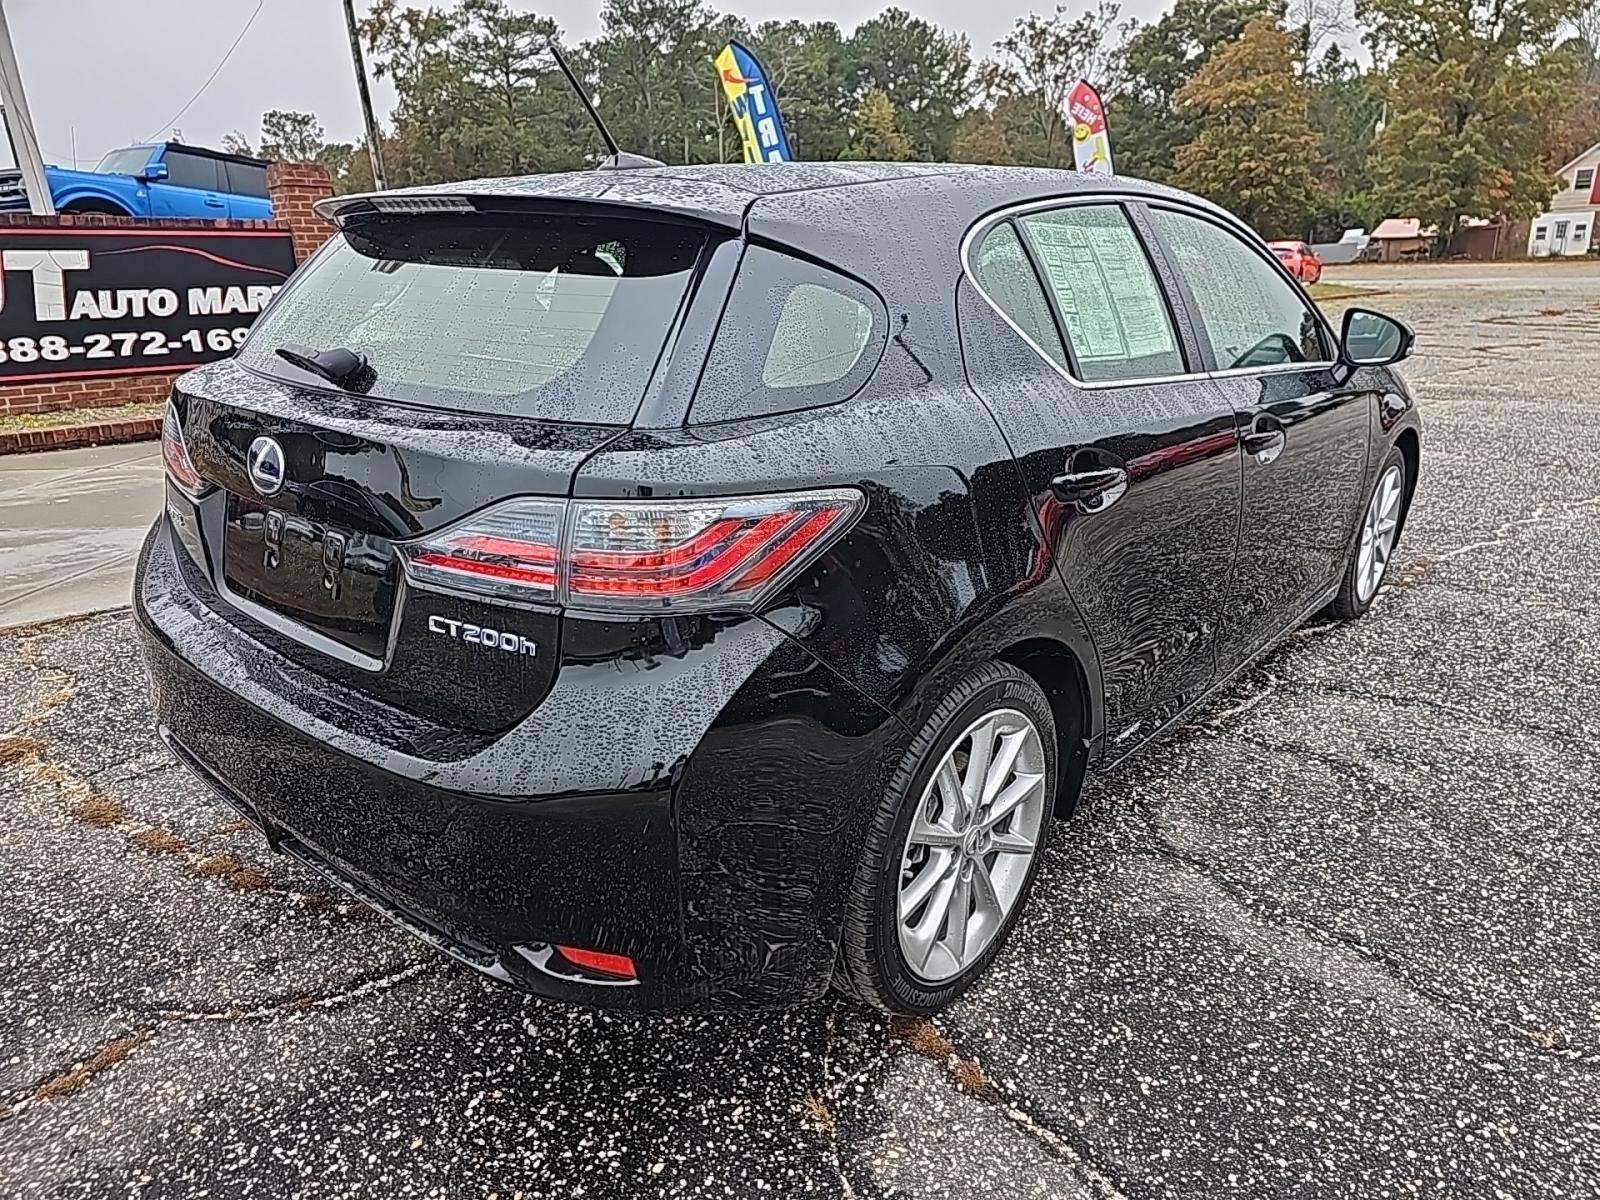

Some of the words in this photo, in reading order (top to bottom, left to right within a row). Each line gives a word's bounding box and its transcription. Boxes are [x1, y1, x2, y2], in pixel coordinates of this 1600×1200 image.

[0, 249, 90, 321] T
[69, 288, 180, 321] AUTO
[428, 615, 537, 657] CT200h
